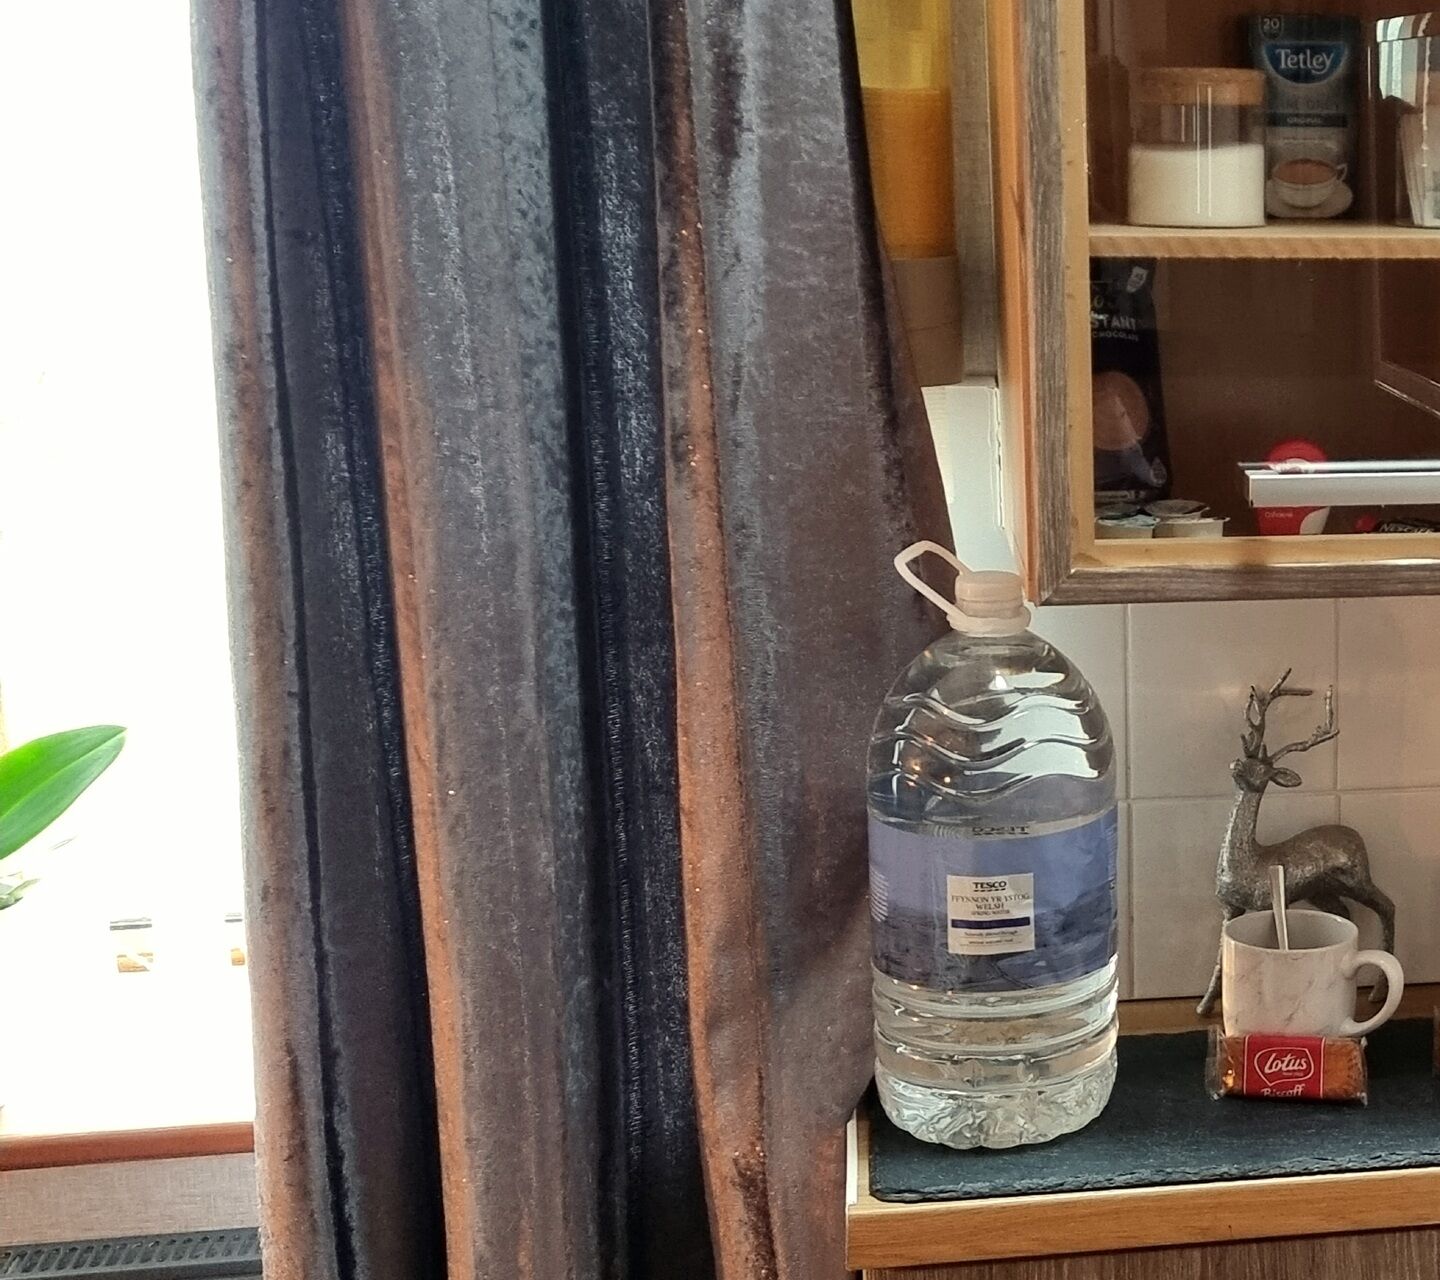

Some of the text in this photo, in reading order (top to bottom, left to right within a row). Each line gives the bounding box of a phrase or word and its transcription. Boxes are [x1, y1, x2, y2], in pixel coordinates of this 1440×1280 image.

[1275, 48, 1334, 75] Tetley
[972, 880, 1008, 889] TESCO
[1264, 1052, 1308, 1073] Lotus
